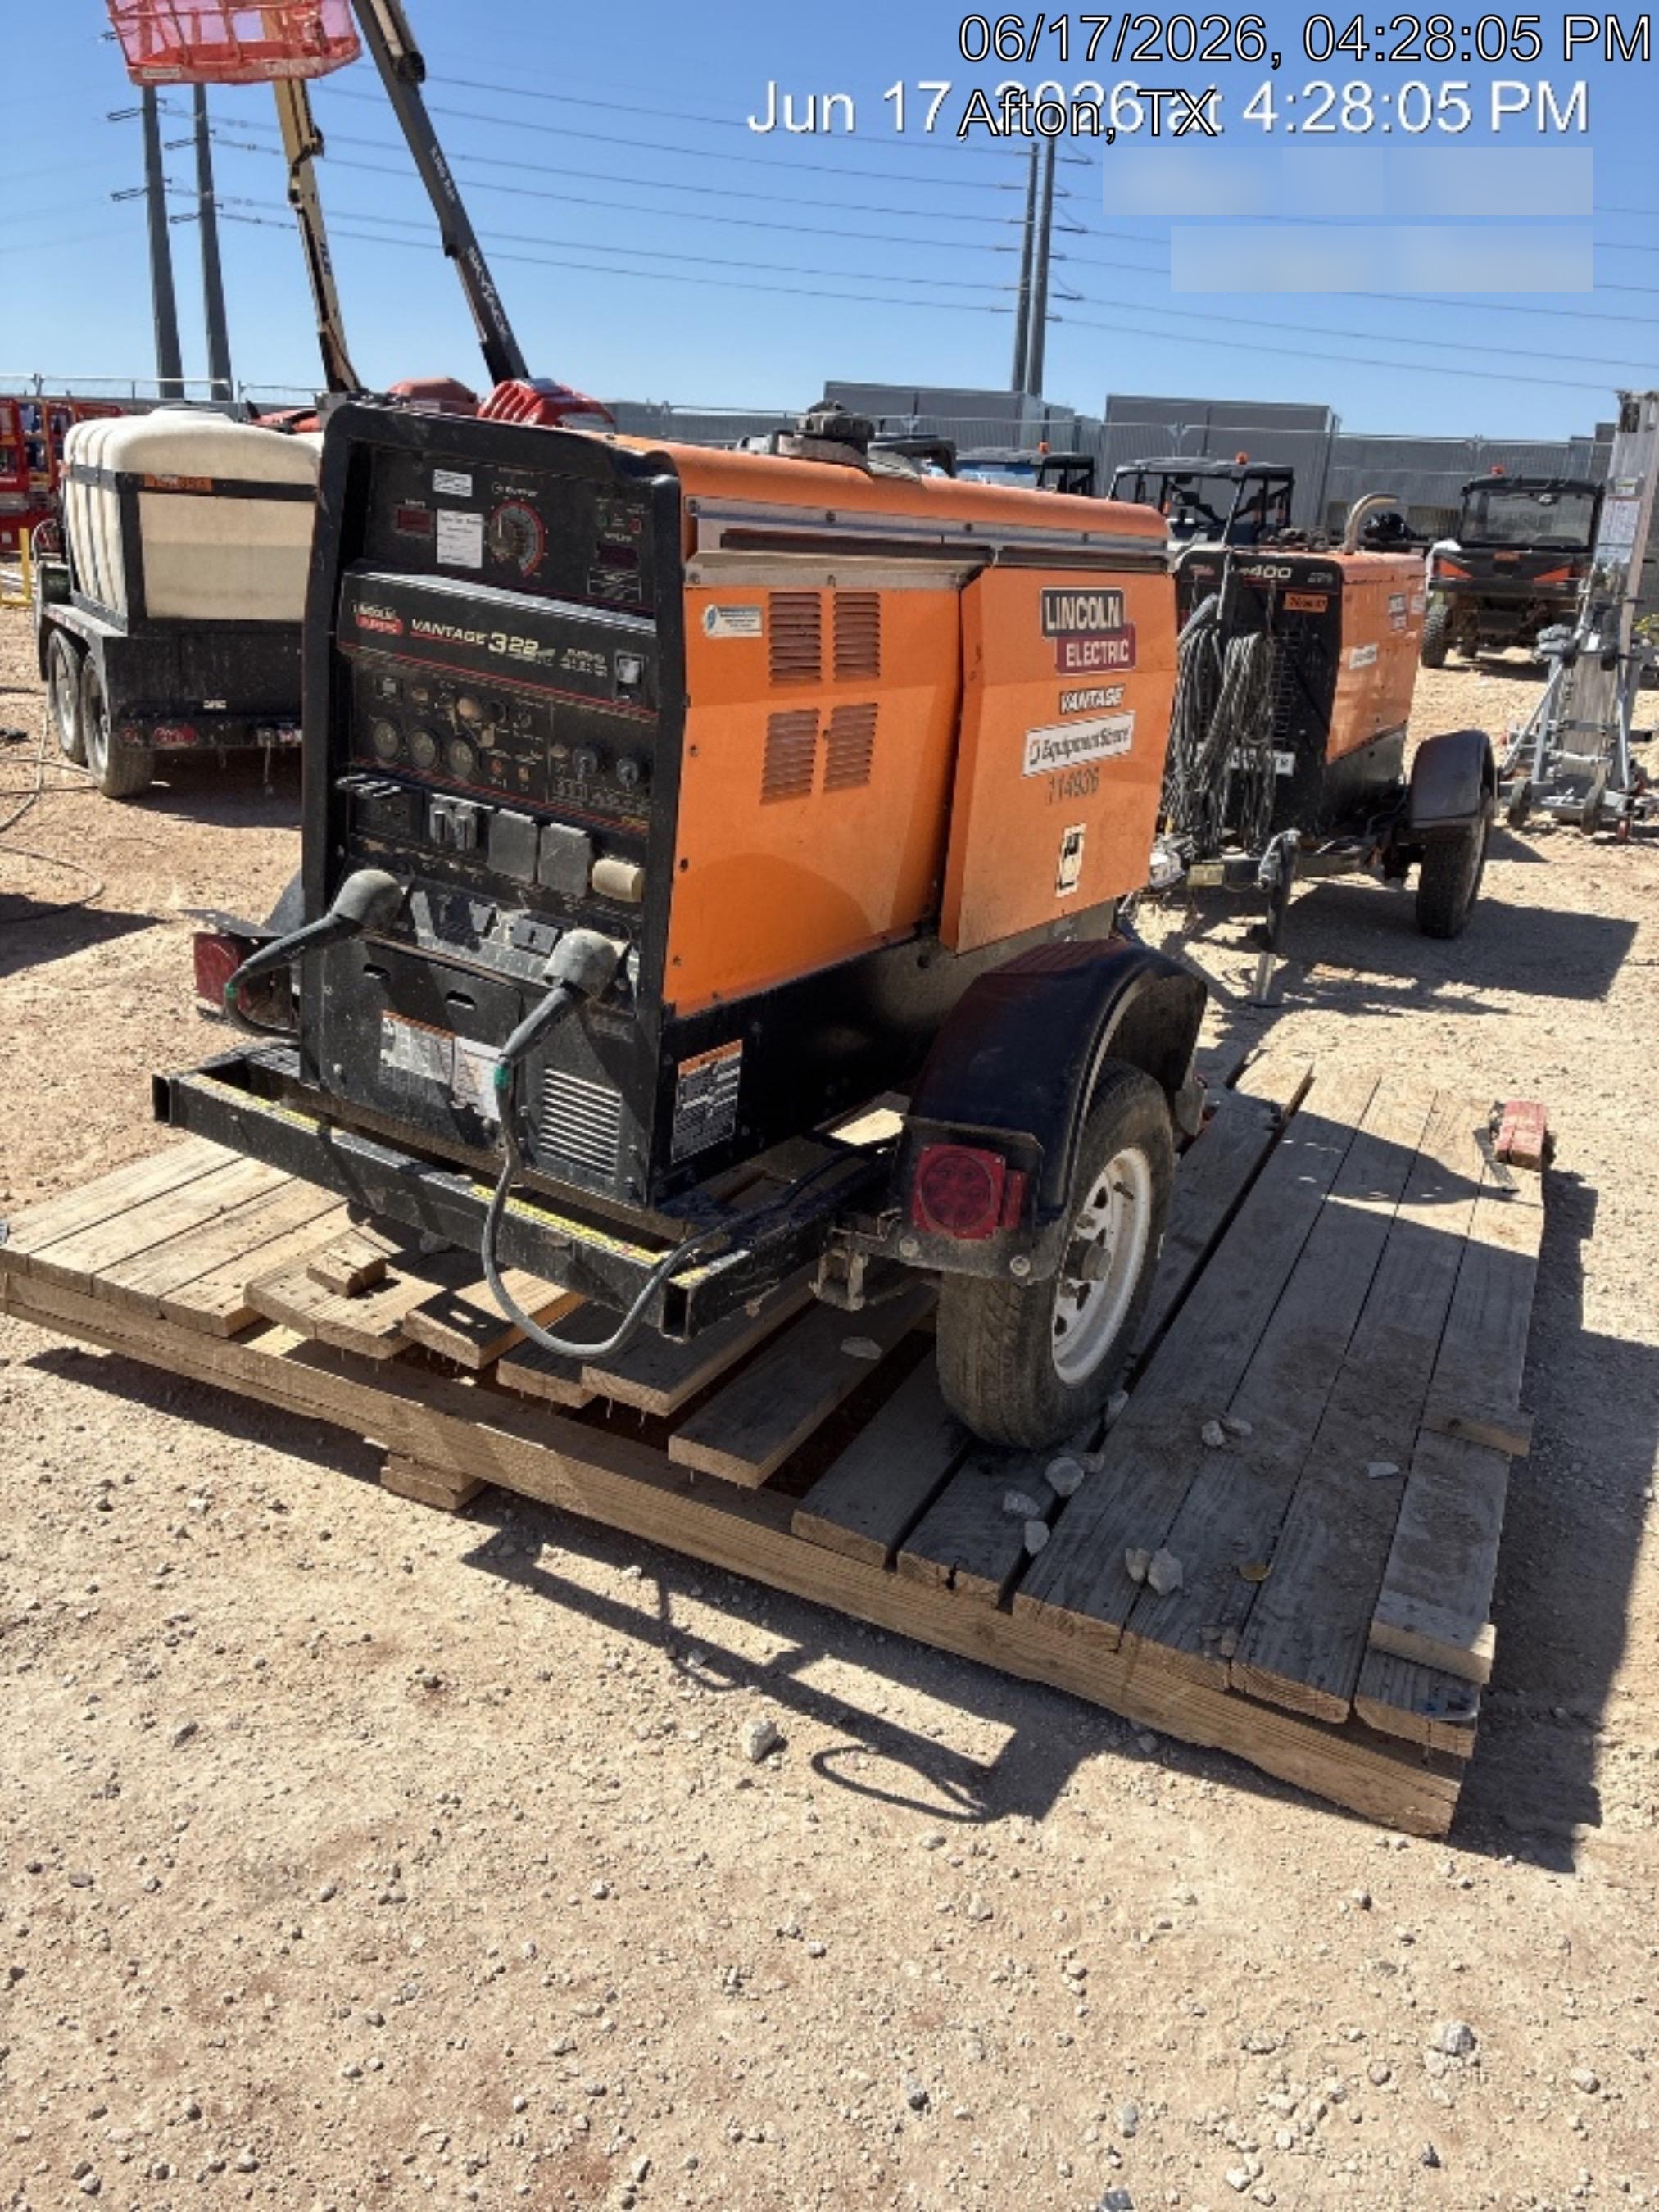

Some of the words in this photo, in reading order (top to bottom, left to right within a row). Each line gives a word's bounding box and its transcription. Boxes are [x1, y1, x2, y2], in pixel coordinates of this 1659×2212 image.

[1045, 596, 1122, 631] LINCOLN
[411, 618, 487, 645] VANTAGE
[1066, 638, 1129, 668] ELECTRIC
